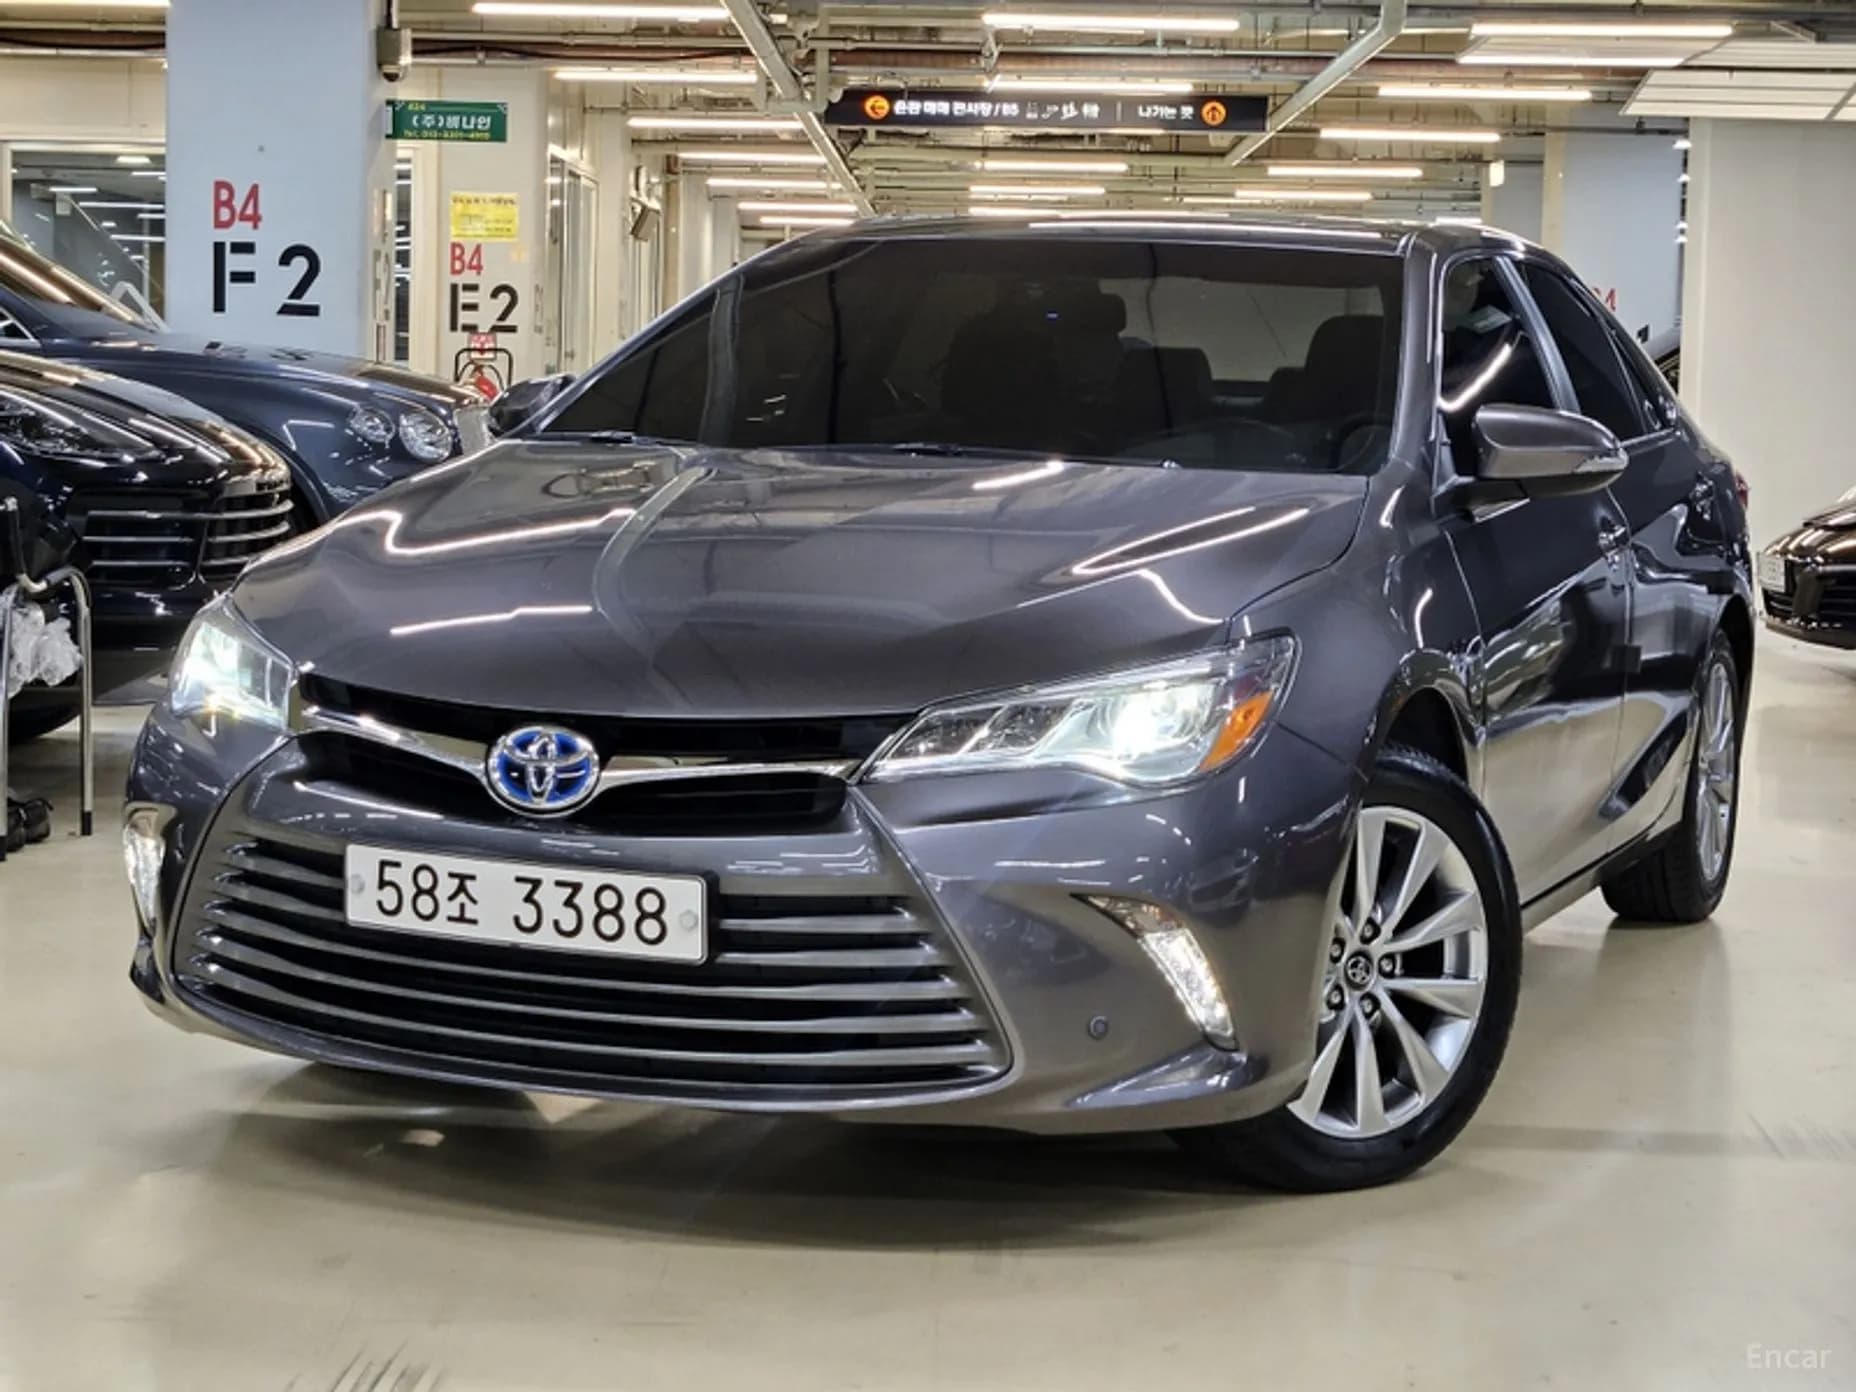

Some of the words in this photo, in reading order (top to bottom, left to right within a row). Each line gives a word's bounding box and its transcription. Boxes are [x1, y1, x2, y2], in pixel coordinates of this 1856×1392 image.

[213, 180, 263, 230] B4
[449, 241, 484, 277] B4
[376, 859, 479, 926] 58조
[513, 876, 668, 946] 3388
